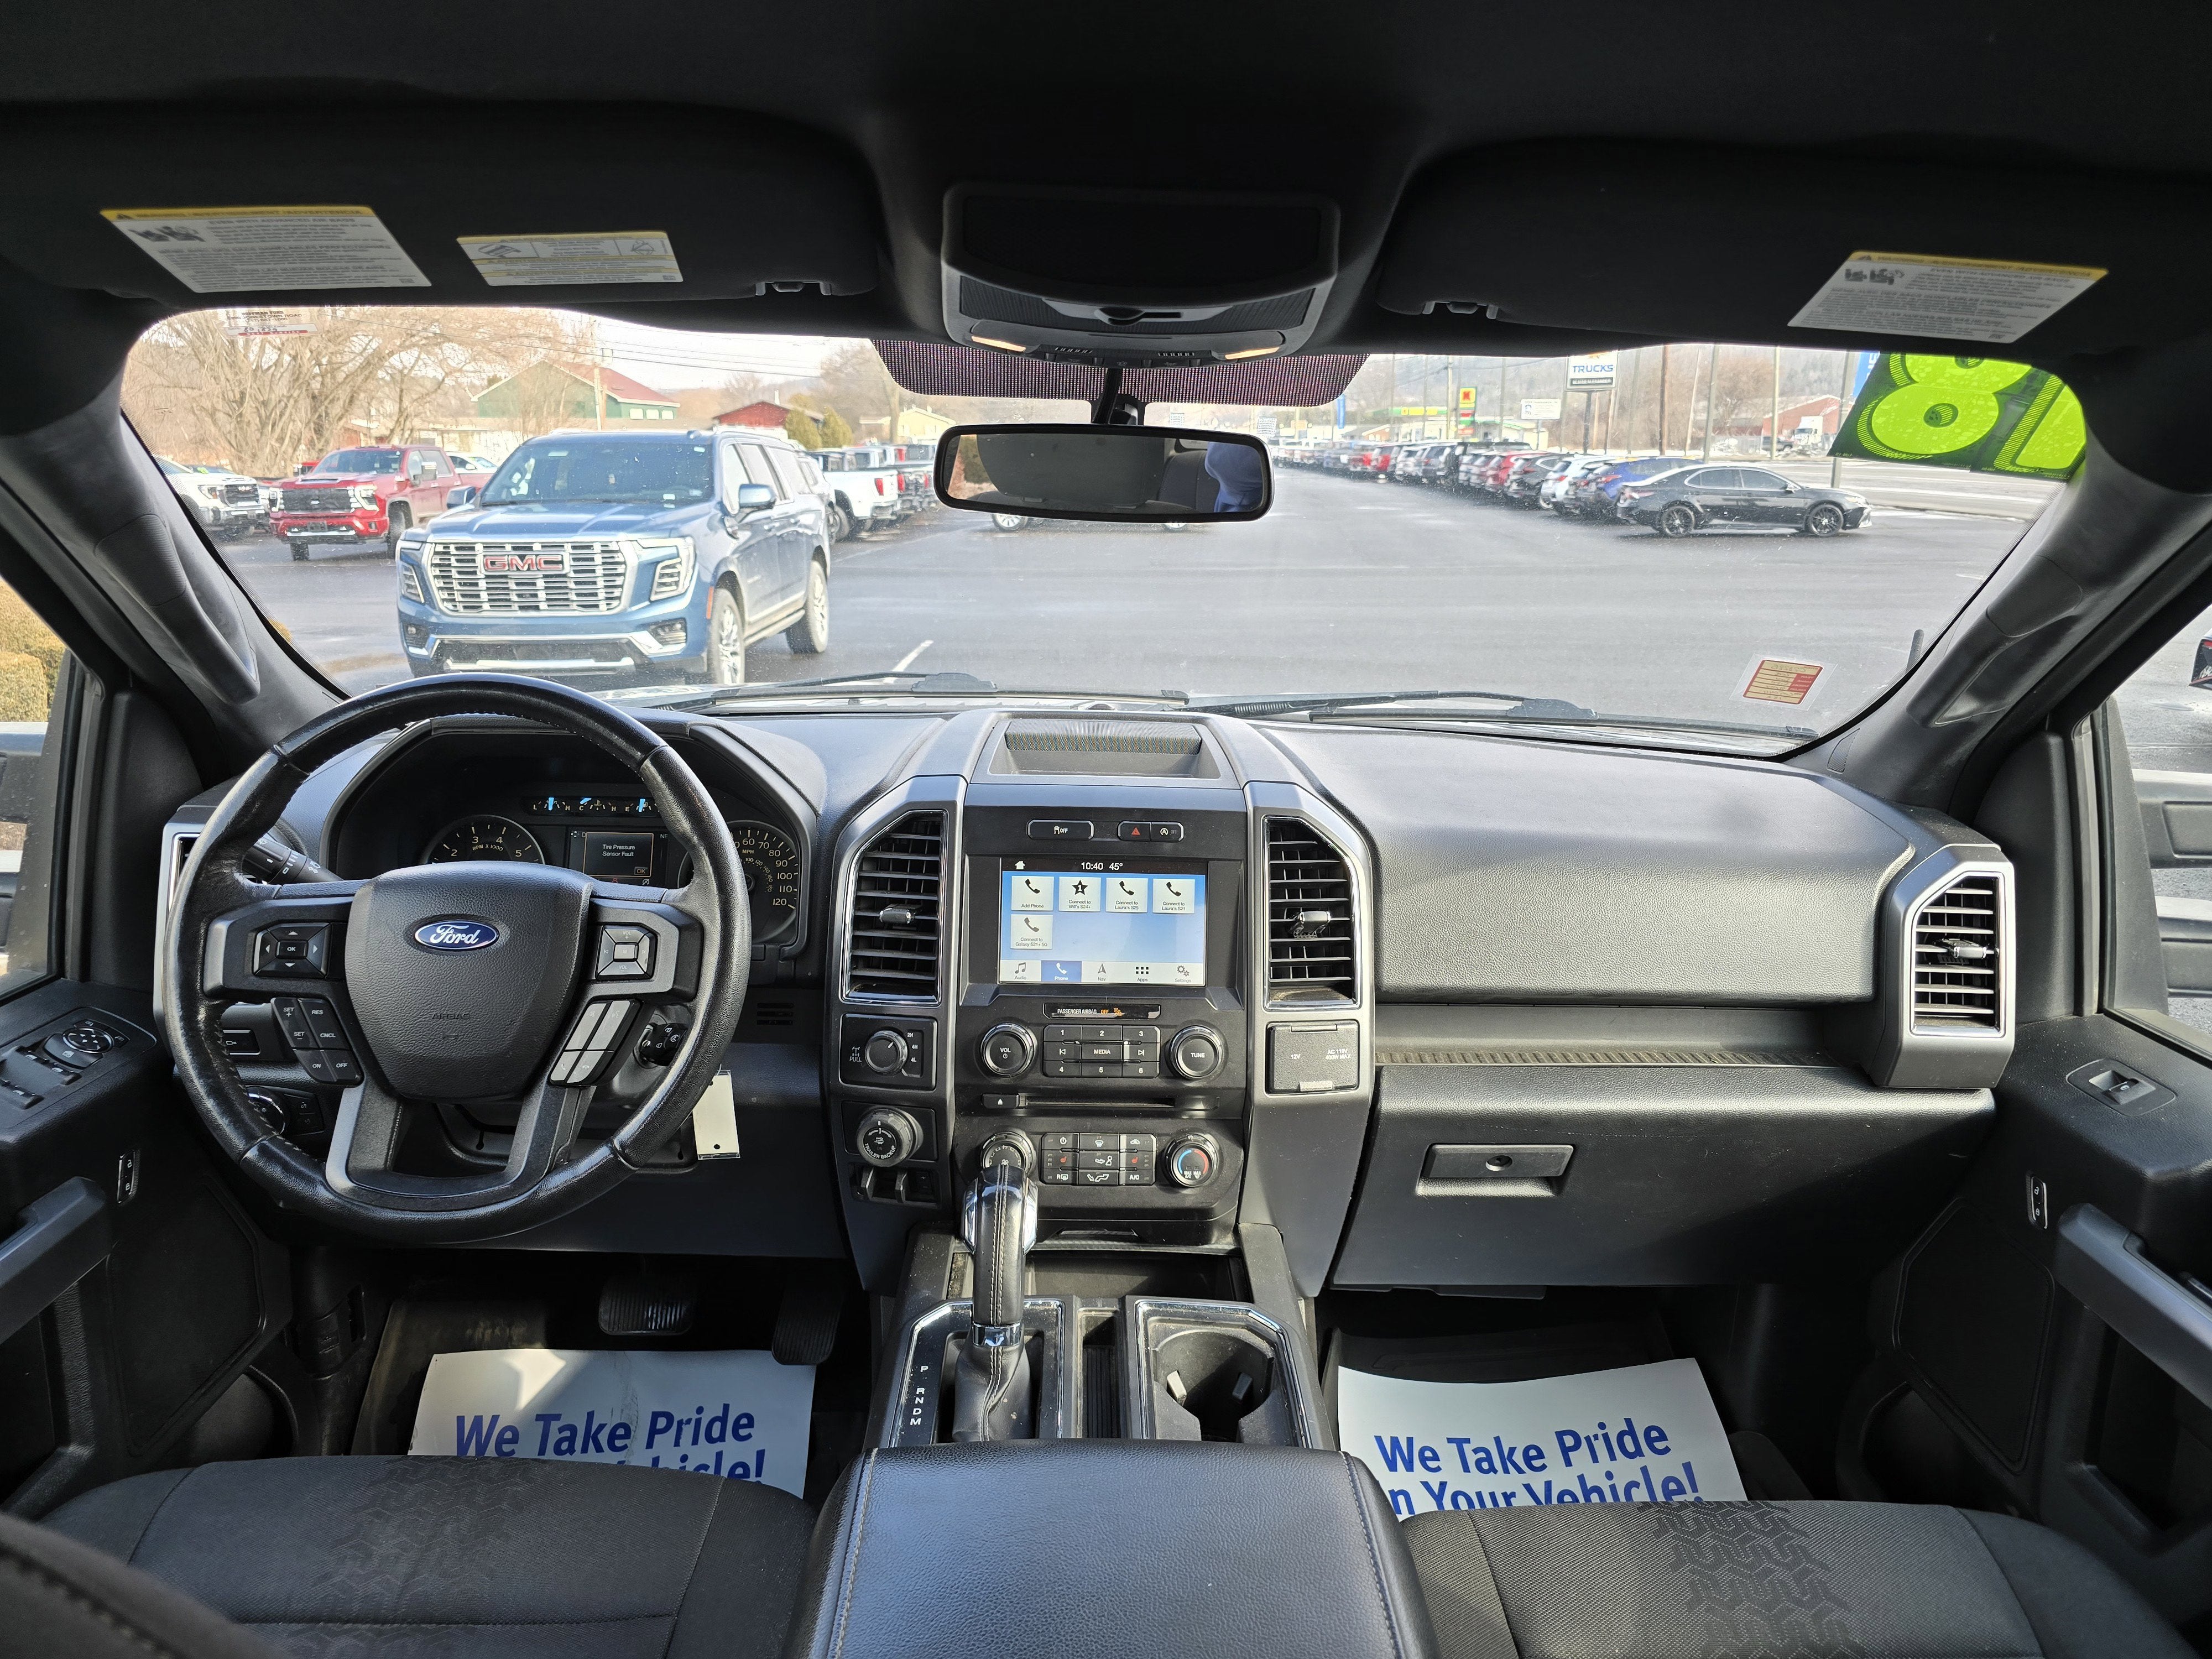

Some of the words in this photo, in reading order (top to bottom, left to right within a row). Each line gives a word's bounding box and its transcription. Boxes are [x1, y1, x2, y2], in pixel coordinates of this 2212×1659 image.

[1573, 364, 1614, 373] TRUCKS
[484, 555, 563, 571] GMC
[1081, 862, 1104, 870] 10:40
[1109, 862, 1123, 871] 45°
[430, 924, 481, 945] Ford
[864, 1142, 880, 1159] TRAILER
[881, 1145, 896, 1160] BACKUP
[455, 1414, 520, 1457] We
[535, 1410, 632, 1457] Take
[645, 1403, 755, 1451] Pride
[1373, 1434, 1442, 1473] We
[1446, 1435, 1547, 1475] Take
[1554, 1417, 1671, 1468] Pride
[1420, 1480, 1517, 1511] Your
